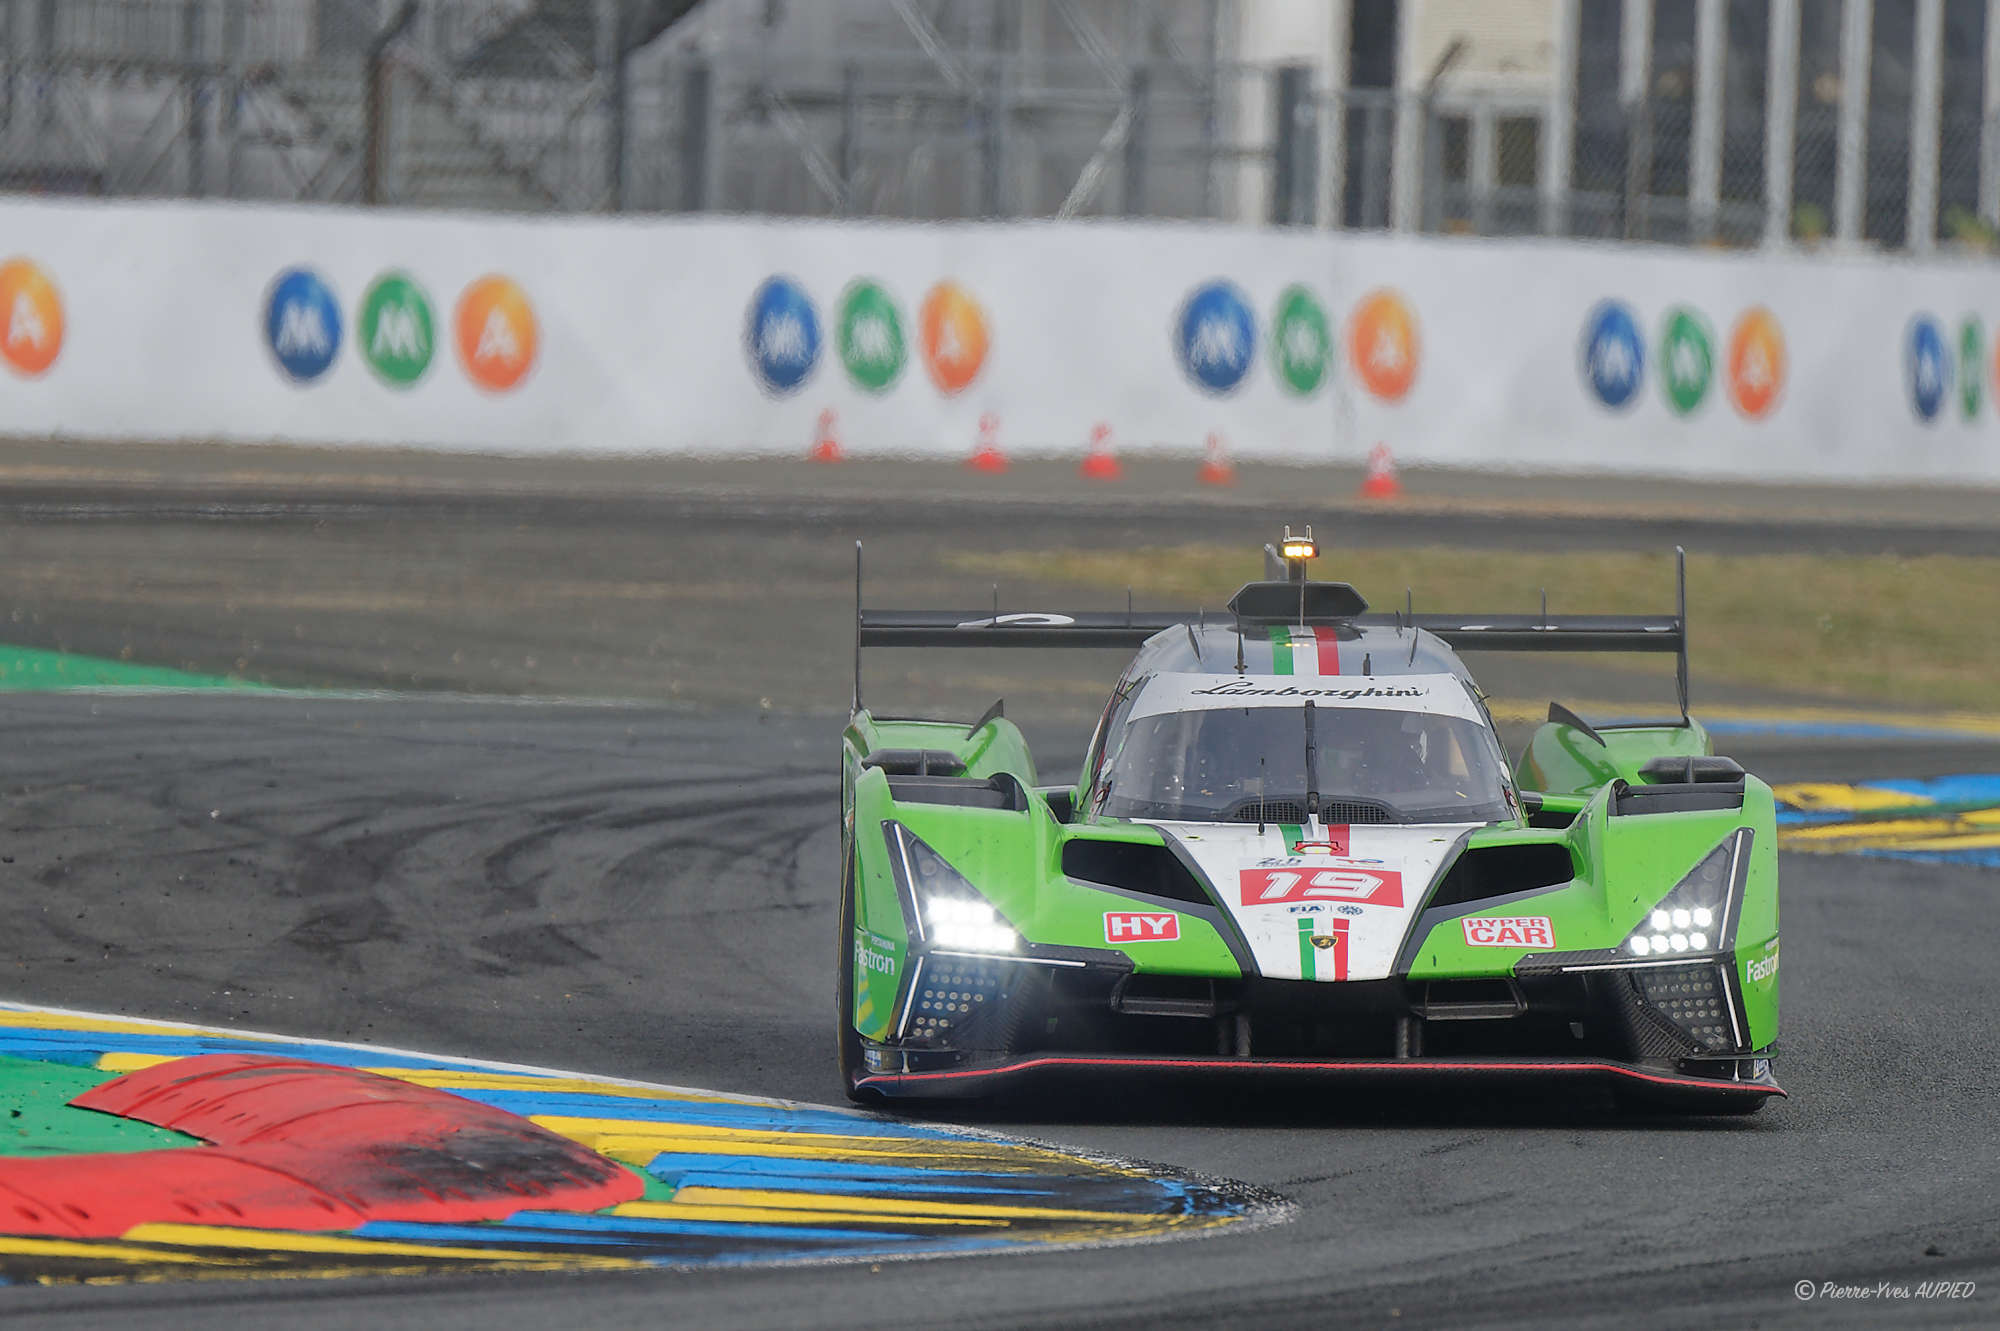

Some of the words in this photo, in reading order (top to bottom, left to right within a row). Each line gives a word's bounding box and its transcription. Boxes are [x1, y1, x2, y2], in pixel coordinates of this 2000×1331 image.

[1191, 681, 1423, 700] Lamborghini
[1260, 871, 1384, 899] 19
[1288, 904, 1322, 915] FIA
[1111, 916, 1172, 936] HY
[1467, 919, 1545, 928] HYPER
[1470, 927, 1548, 944] CAR
